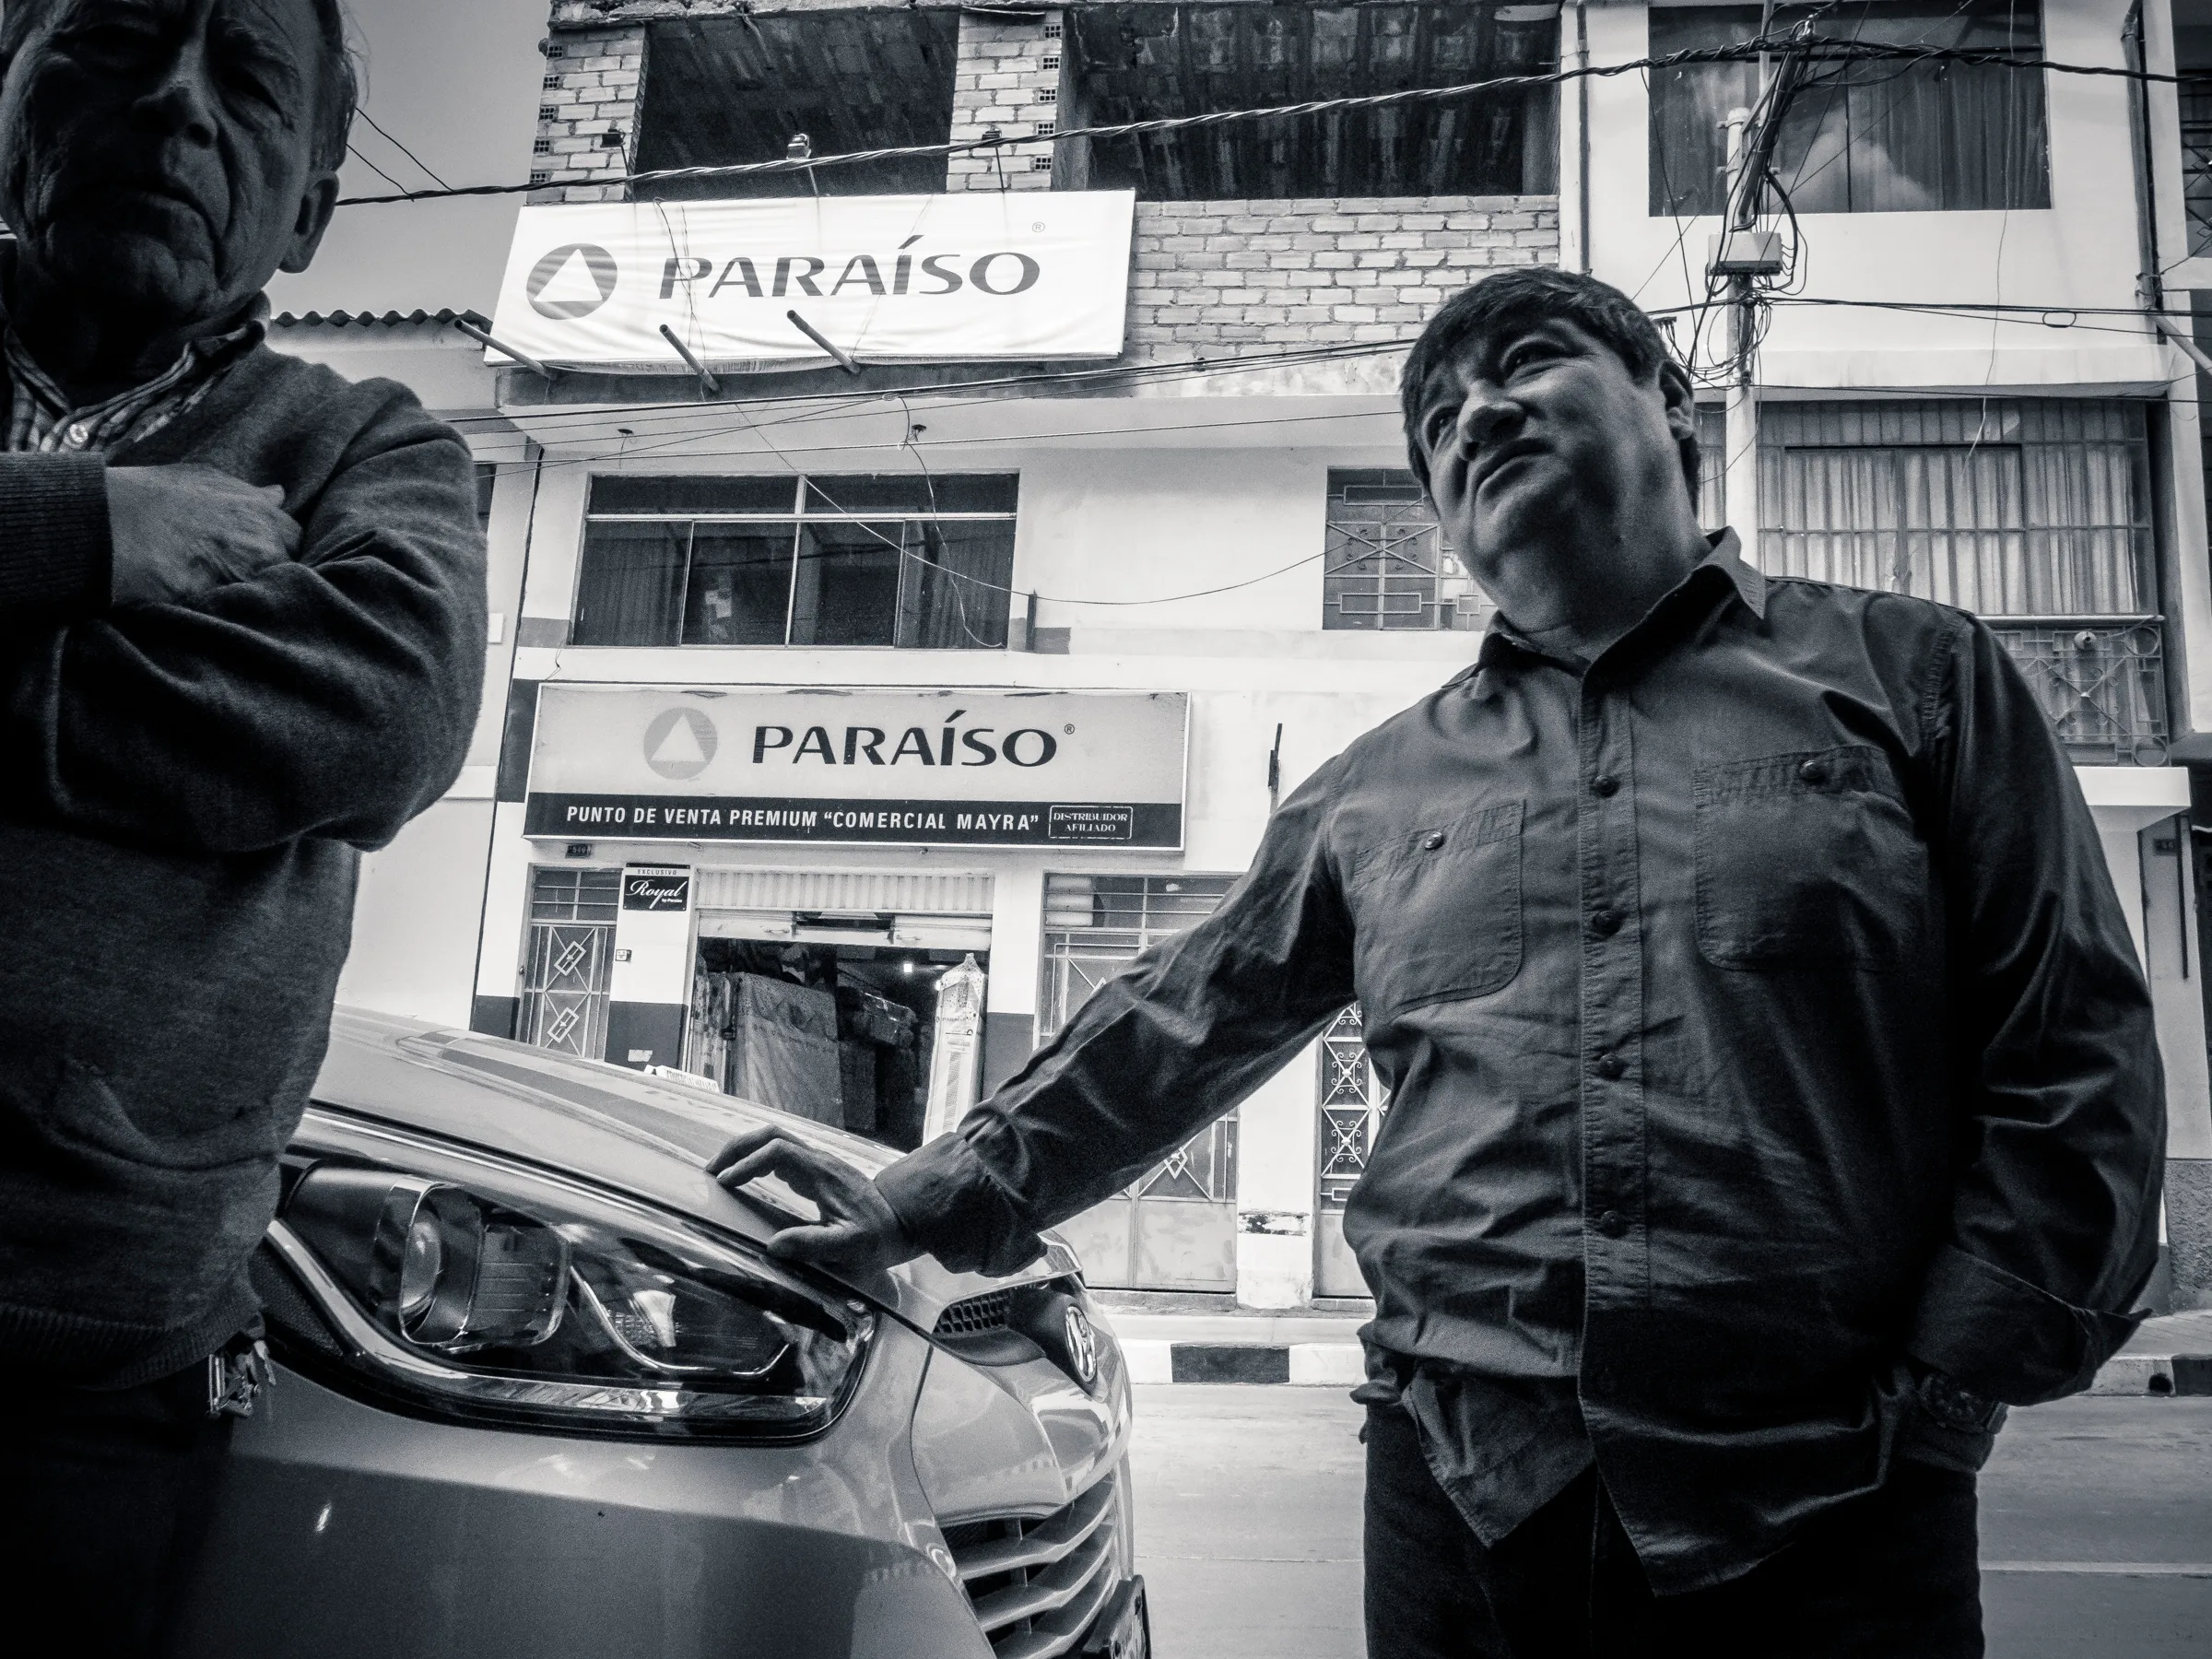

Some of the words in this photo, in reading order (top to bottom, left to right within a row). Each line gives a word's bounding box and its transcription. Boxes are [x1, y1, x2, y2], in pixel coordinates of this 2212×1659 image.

[658, 234, 1041, 300] PARAÍSO
[752, 710, 1057, 768] PARAÍSO
[567, 806, 626, 824] PUNTO
[633, 807, 657, 825] DE
[665, 808, 722, 826] VENTA
[729, 809, 818, 828] PREMIUM
[824, 811, 947, 830] “COMERCIAL
[957, 814, 1039, 831] MAYRA”
[1053, 812, 1128, 822] DISTRIBUIDOR
[1065, 823, 1117, 832] AFILIADO
[625, 878, 688, 910] Royal
